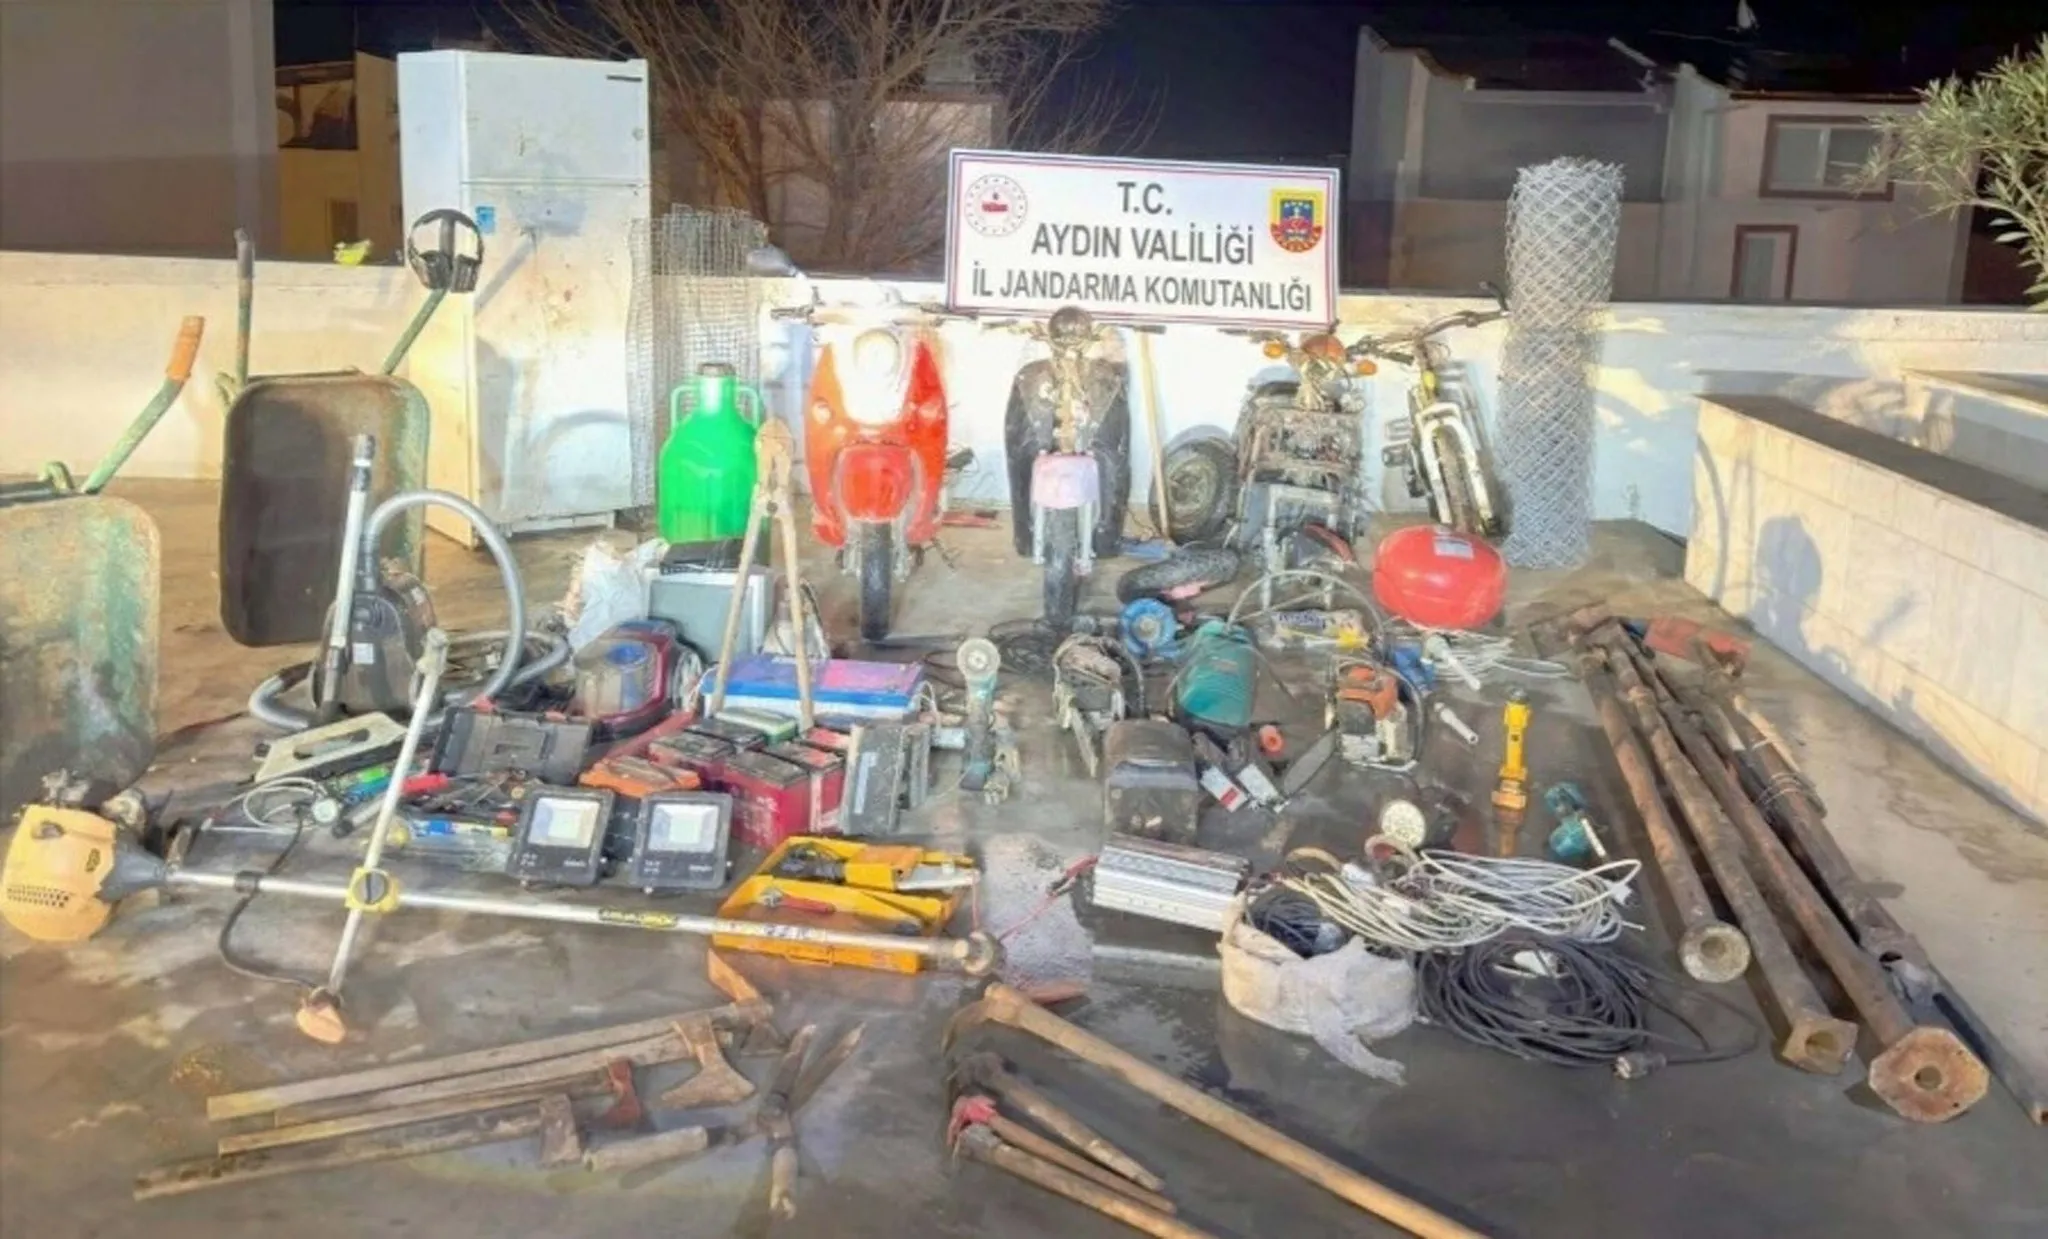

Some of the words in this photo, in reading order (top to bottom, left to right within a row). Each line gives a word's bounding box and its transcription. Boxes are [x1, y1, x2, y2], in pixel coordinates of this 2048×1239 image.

[1117, 181, 1173, 215] T.C.
[1031, 223, 1121, 259] AYDIN
[1131, 223, 1254, 265] VALİLİĞİ
[972, 261, 993, 297] İL
[1000, 268, 1137, 303] JANDARMA
[1144, 275, 1312, 312] KOMUTANLIĞI
